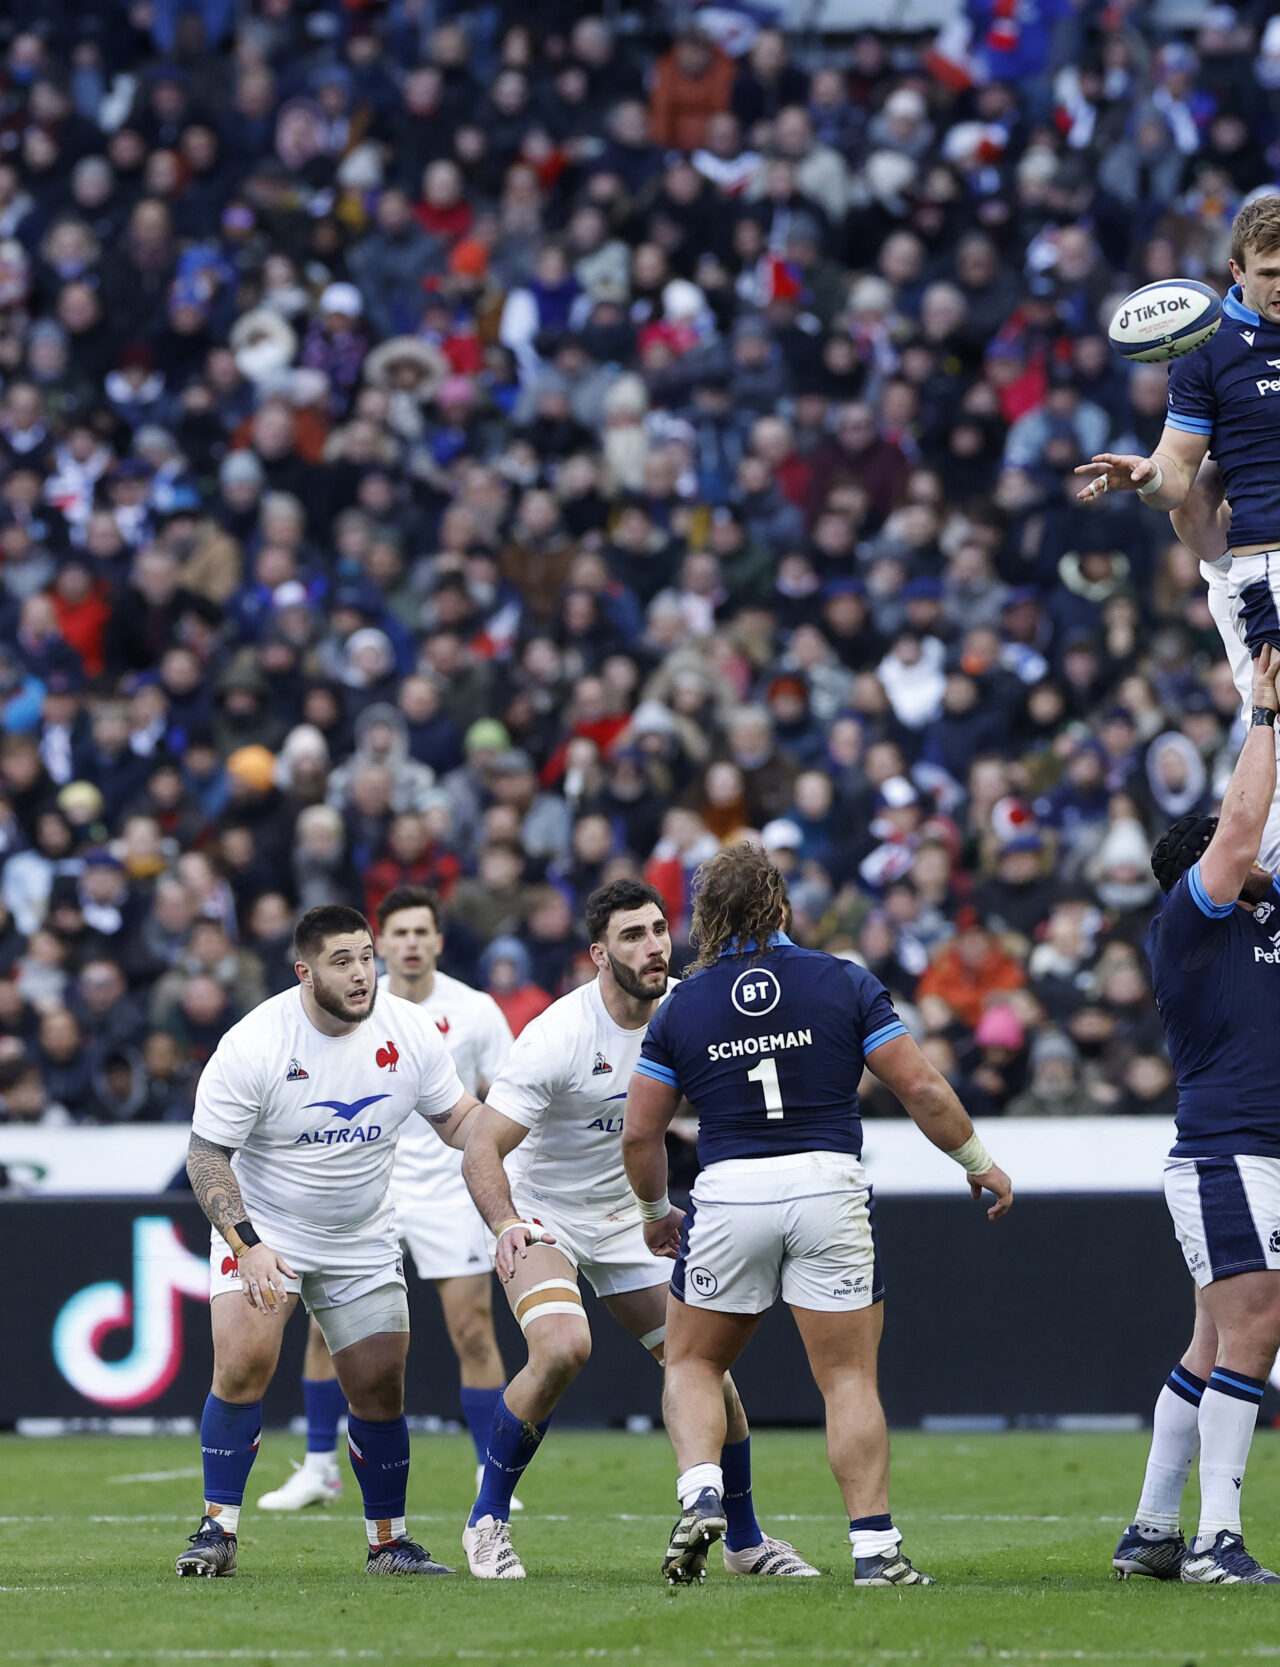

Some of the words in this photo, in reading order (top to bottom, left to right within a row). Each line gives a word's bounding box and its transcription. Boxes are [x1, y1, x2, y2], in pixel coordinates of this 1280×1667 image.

[1133, 297, 1191, 322] TikTok
[742, 981, 769, 1003] BT
[707, 1028, 813, 1062] SCHOEMAN
[747, 1057, 784, 1119] 1
[295, 1125, 382, 1145] ALTRAD
[587, 1117, 624, 1133] ALT
[696, 1273, 712, 1288] BT
[833, 1288, 852, 1296] Peter
[853, 1284, 869, 1294] Vardy
